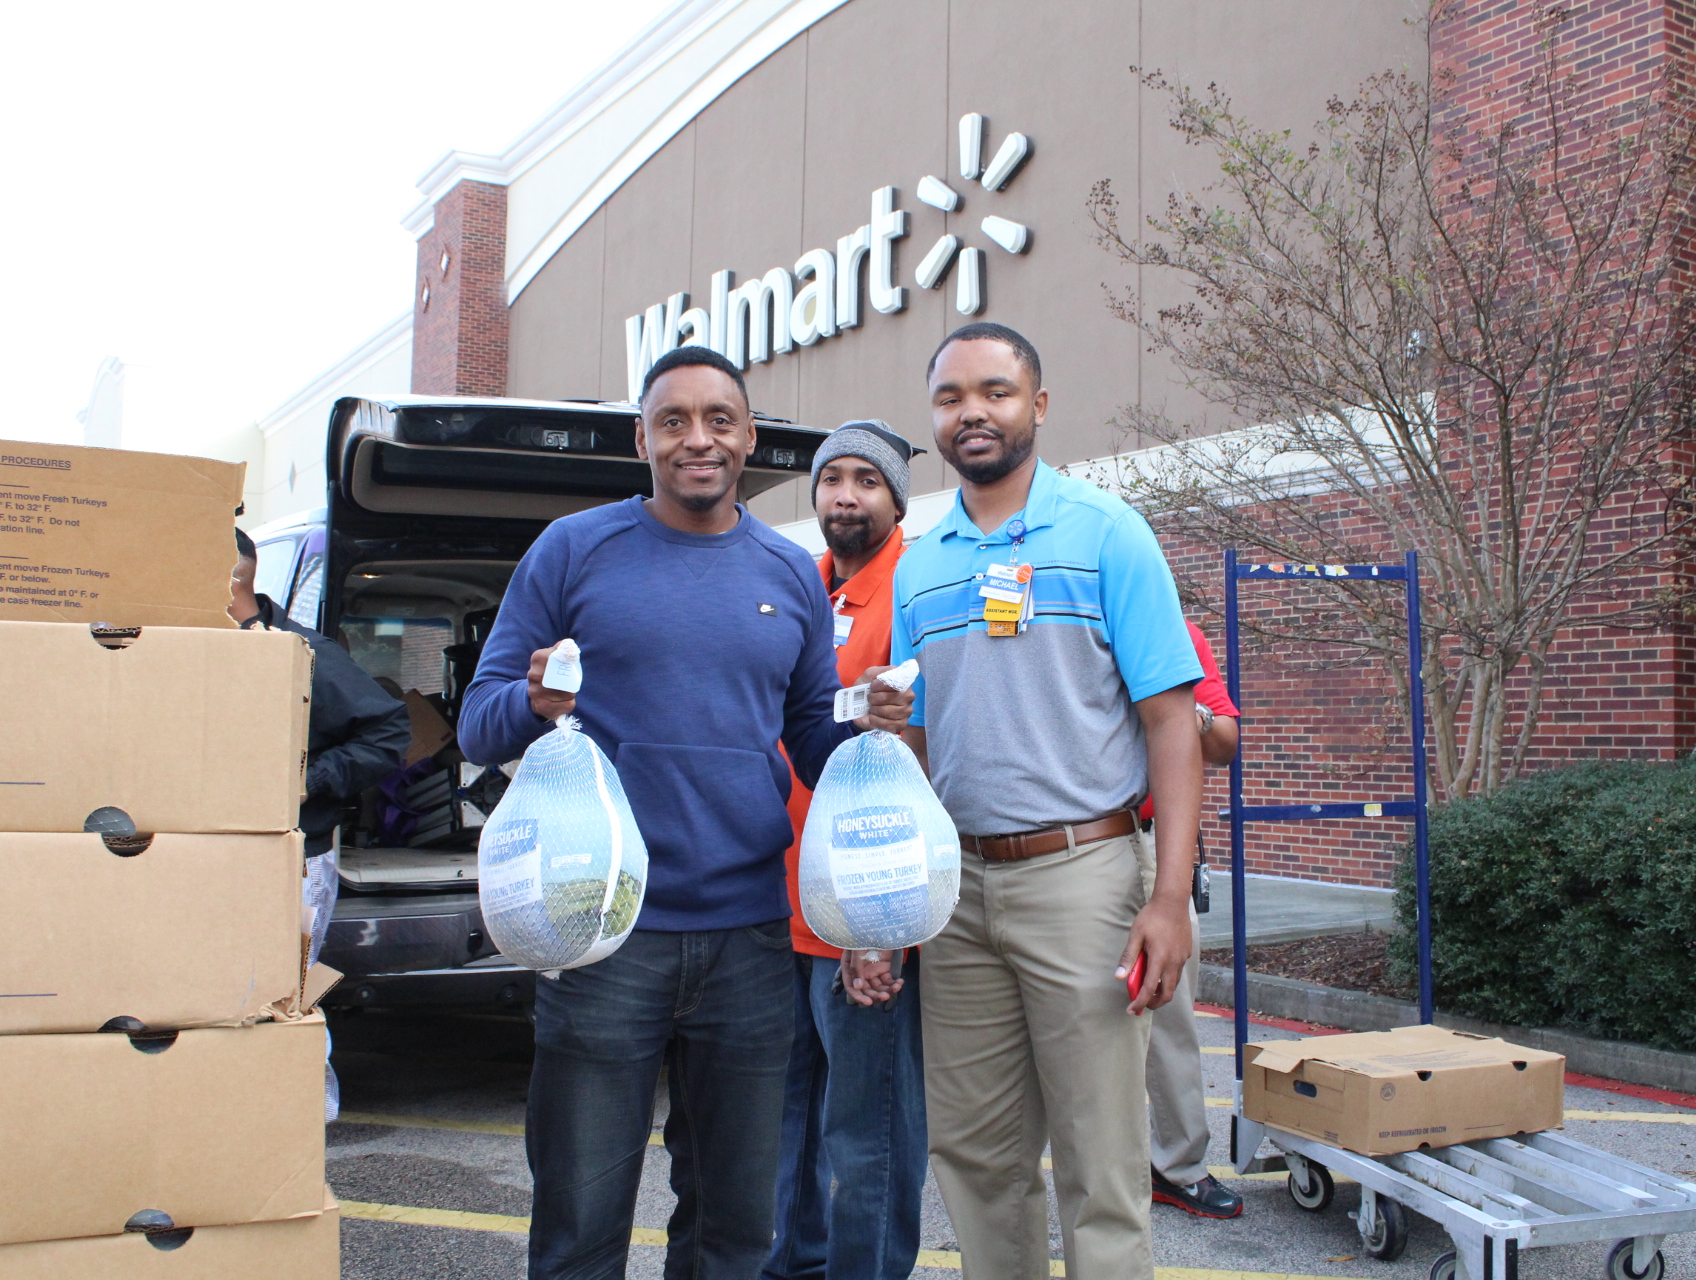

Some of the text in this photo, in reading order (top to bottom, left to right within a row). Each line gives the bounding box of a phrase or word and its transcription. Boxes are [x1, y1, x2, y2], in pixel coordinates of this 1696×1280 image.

[625, 186, 904, 404] Walmart
[1, 455, 71, 469] PROCEDURES
[14, 493, 40, 501] move
[42, 494, 69, 503] Fresh
[71, 496, 107, 508] Turkeys
[27, 504, 42, 512] 32°
[44, 505, 52, 513] F.
[20, 515, 34, 523] 32°
[37, 516, 45, 524] F.
[49, 517, 63, 525] Do
[65, 519, 80, 527] not
[26, 526, 45, 535] line.
[14, 564, 39, 572] move
[41, 565, 73, 575] Frozen
[75, 567, 110, 579] Turkeys
[21, 575, 51, 584] below.
[989, 578, 1019, 591] MICHAEL
[6, 586, 56, 596] maintained
[58, 589, 67, 597] at
[31, 598, 62, 607] freezer
[64, 599, 83, 608] line.
[837, 811, 911, 833] HONEYSUCKLE
[836, 872, 866, 886] FROZEN
[865, 868, 893, 883] YOUNG
[893, 863, 922, 878] TURKEY
[509, 877, 535, 895] TURKEY
[1391, 1128, 1422, 1138] REFRIGERATED
[1430, 1126, 1447, 1134] FROZEN
